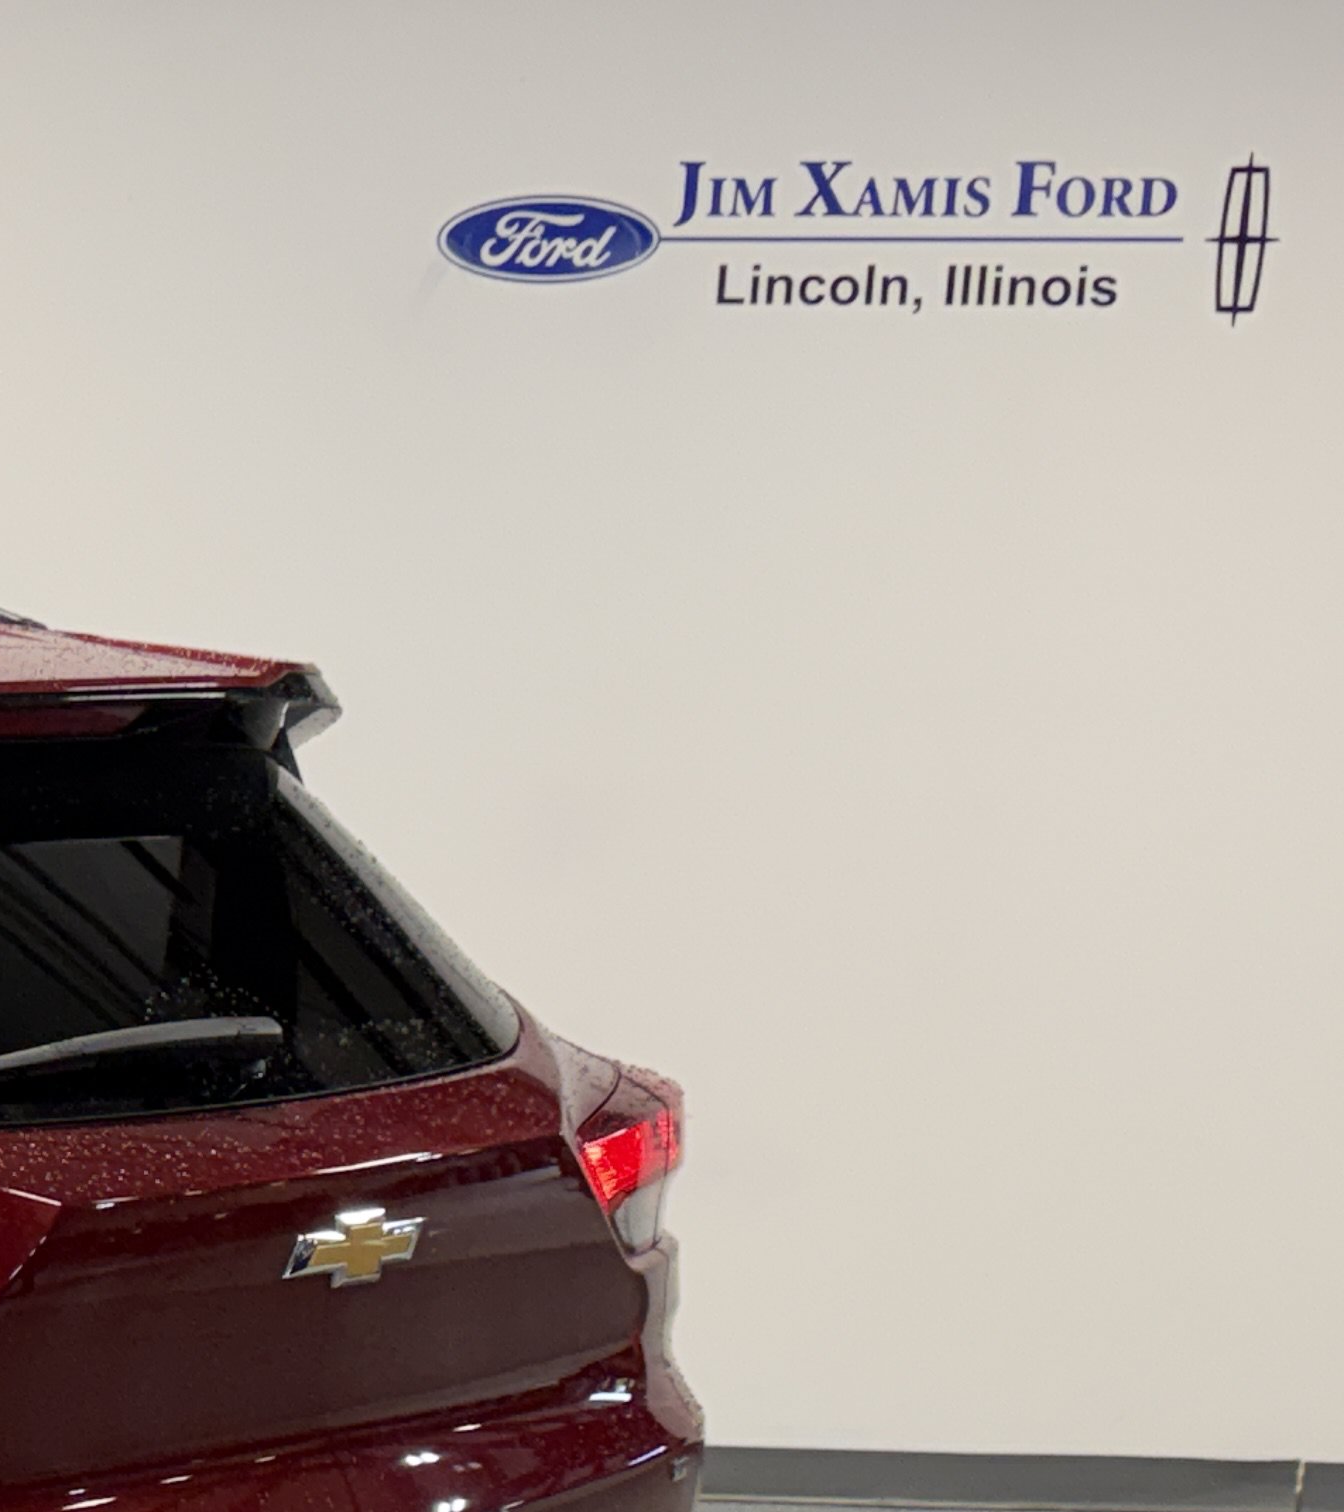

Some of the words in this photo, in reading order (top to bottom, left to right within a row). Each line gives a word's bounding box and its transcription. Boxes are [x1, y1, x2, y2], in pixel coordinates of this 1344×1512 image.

[673, 161, 777, 227] JIM
[794, 161, 990, 218] XAMIS
[1011, 160, 1178, 218] FORD
[480, 210, 617, 268] Ford
[716, 264, 923, 314] Lincoln,
[944, 264, 1117, 308] Illinois
